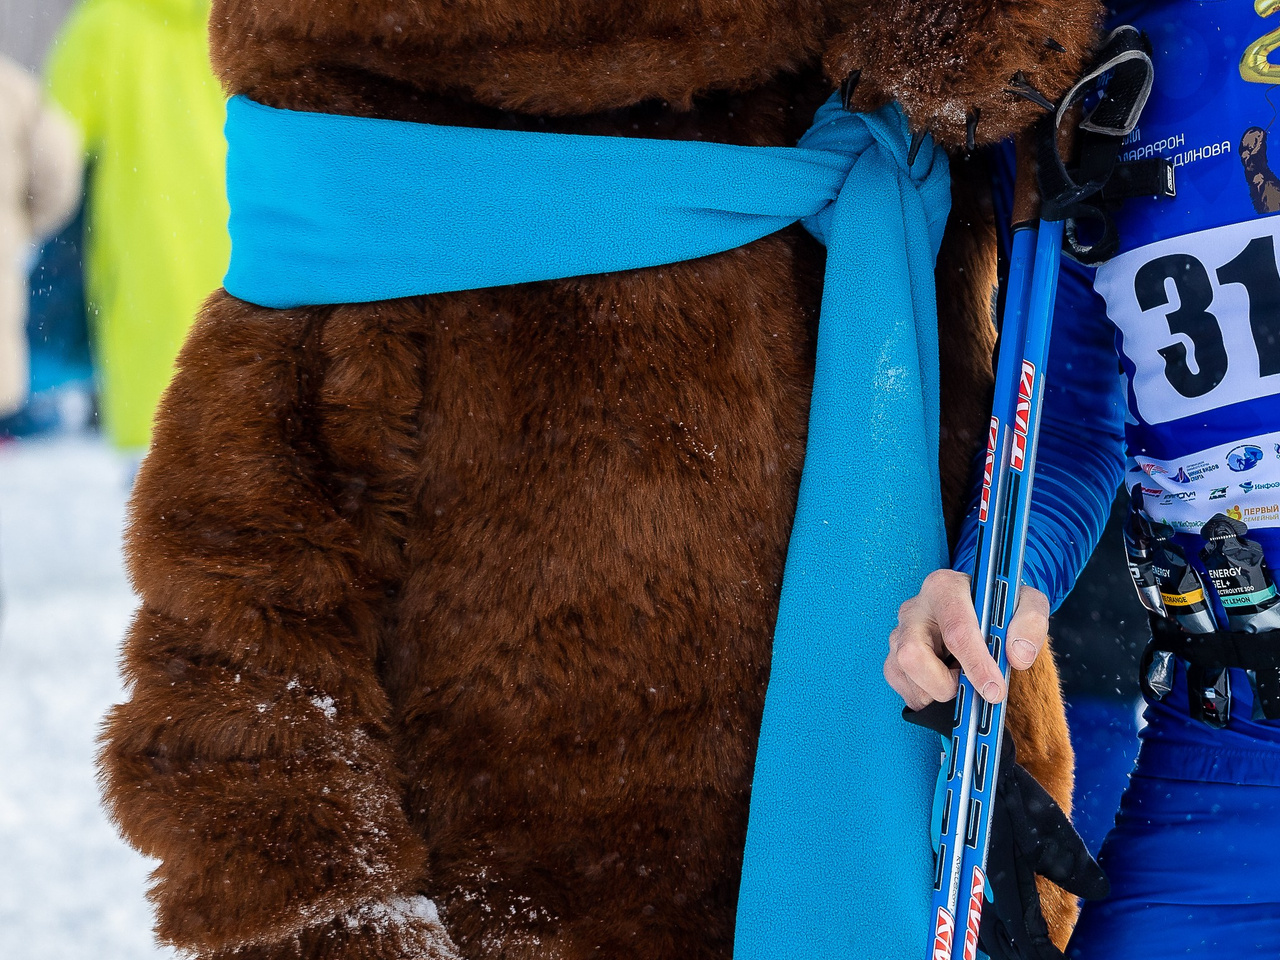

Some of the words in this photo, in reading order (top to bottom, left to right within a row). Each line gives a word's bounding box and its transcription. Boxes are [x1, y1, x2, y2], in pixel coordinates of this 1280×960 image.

[1165, 141, 1231, 168] ДИНОВА
[1243, 503, 1280, 516] ПЕРВЫЙ
[1208, 567, 1242, 579] ENERGY
[1229, 597, 1251, 605] LEMON
